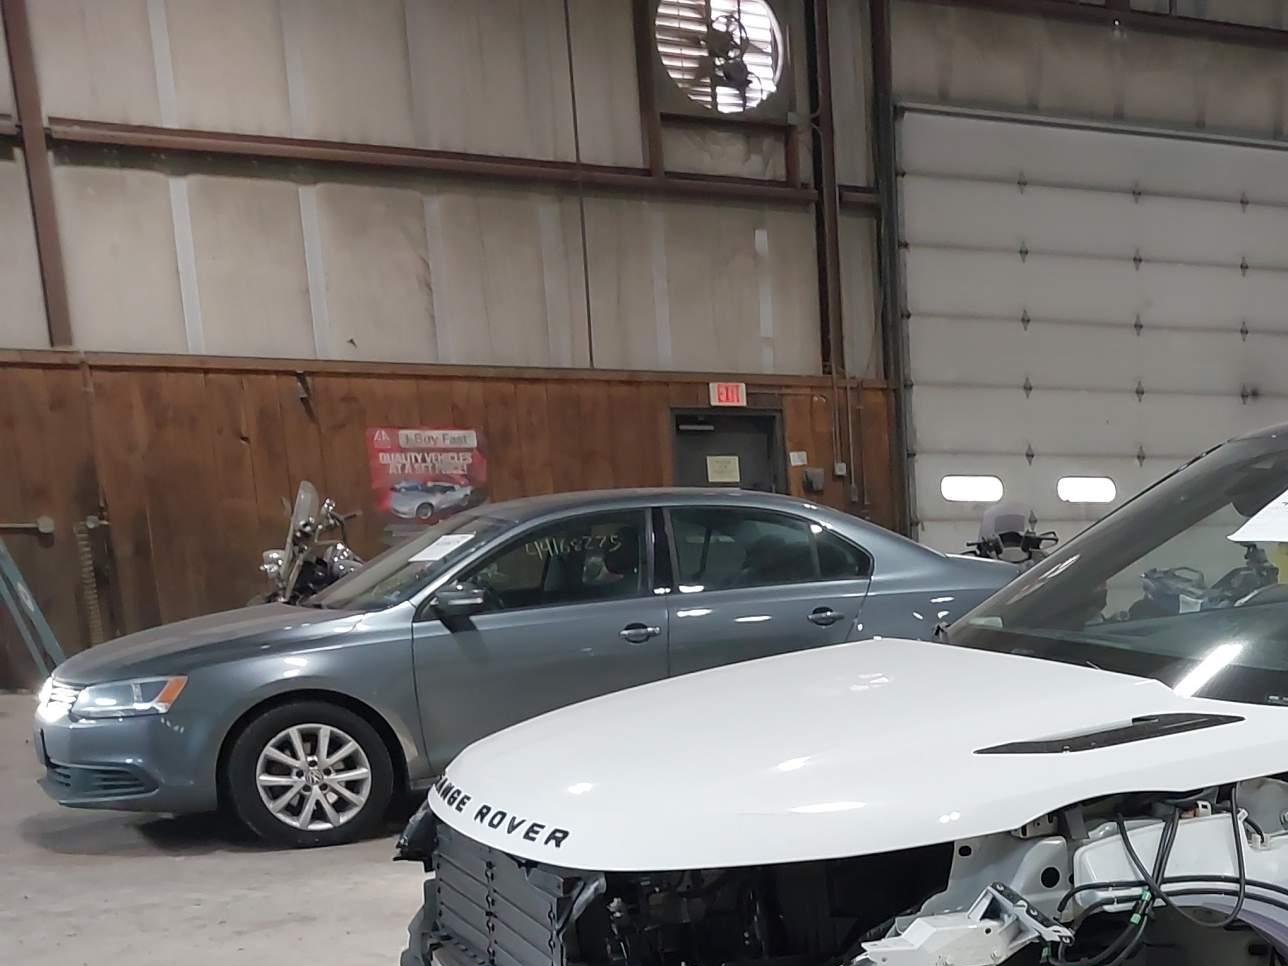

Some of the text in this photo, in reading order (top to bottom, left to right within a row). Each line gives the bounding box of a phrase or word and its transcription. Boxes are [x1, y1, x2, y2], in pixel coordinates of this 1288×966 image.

[378, 452, 422, 464] QUALITY
[435, 777, 570, 848] ANGE ROVER
